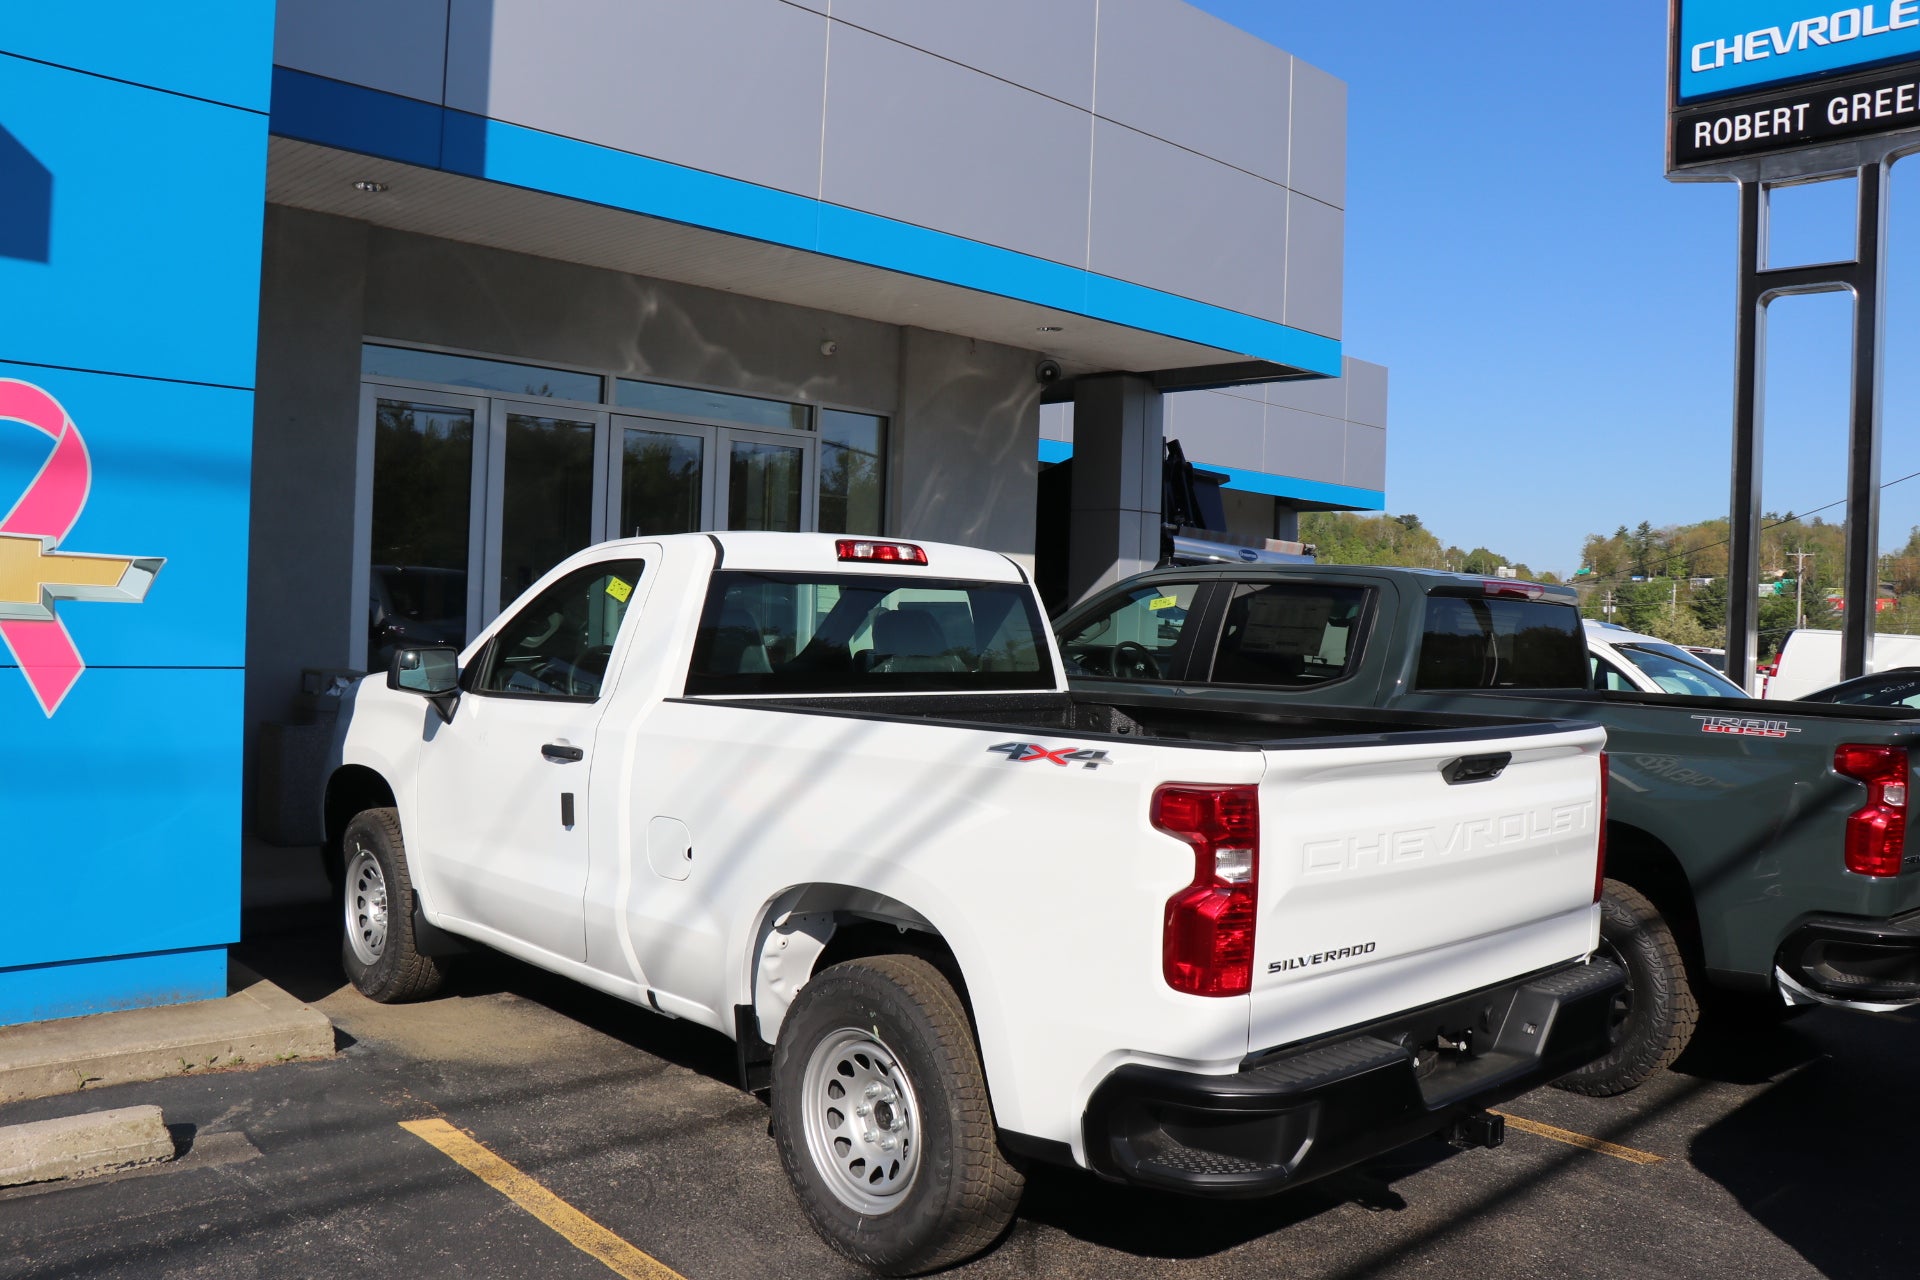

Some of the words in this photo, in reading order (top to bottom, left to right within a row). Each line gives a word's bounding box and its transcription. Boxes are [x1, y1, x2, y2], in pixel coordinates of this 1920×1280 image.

[1694, 103, 1810, 149] ROBERT
[1827, 82, 1920, 126] GREE
[1691, 714, 1802, 733] TRAIL
[1702, 723, 1787, 738] BOSS
[1301, 800, 1593, 876] CHEVROLET
[1267, 941, 1376, 974] SILVERADO
